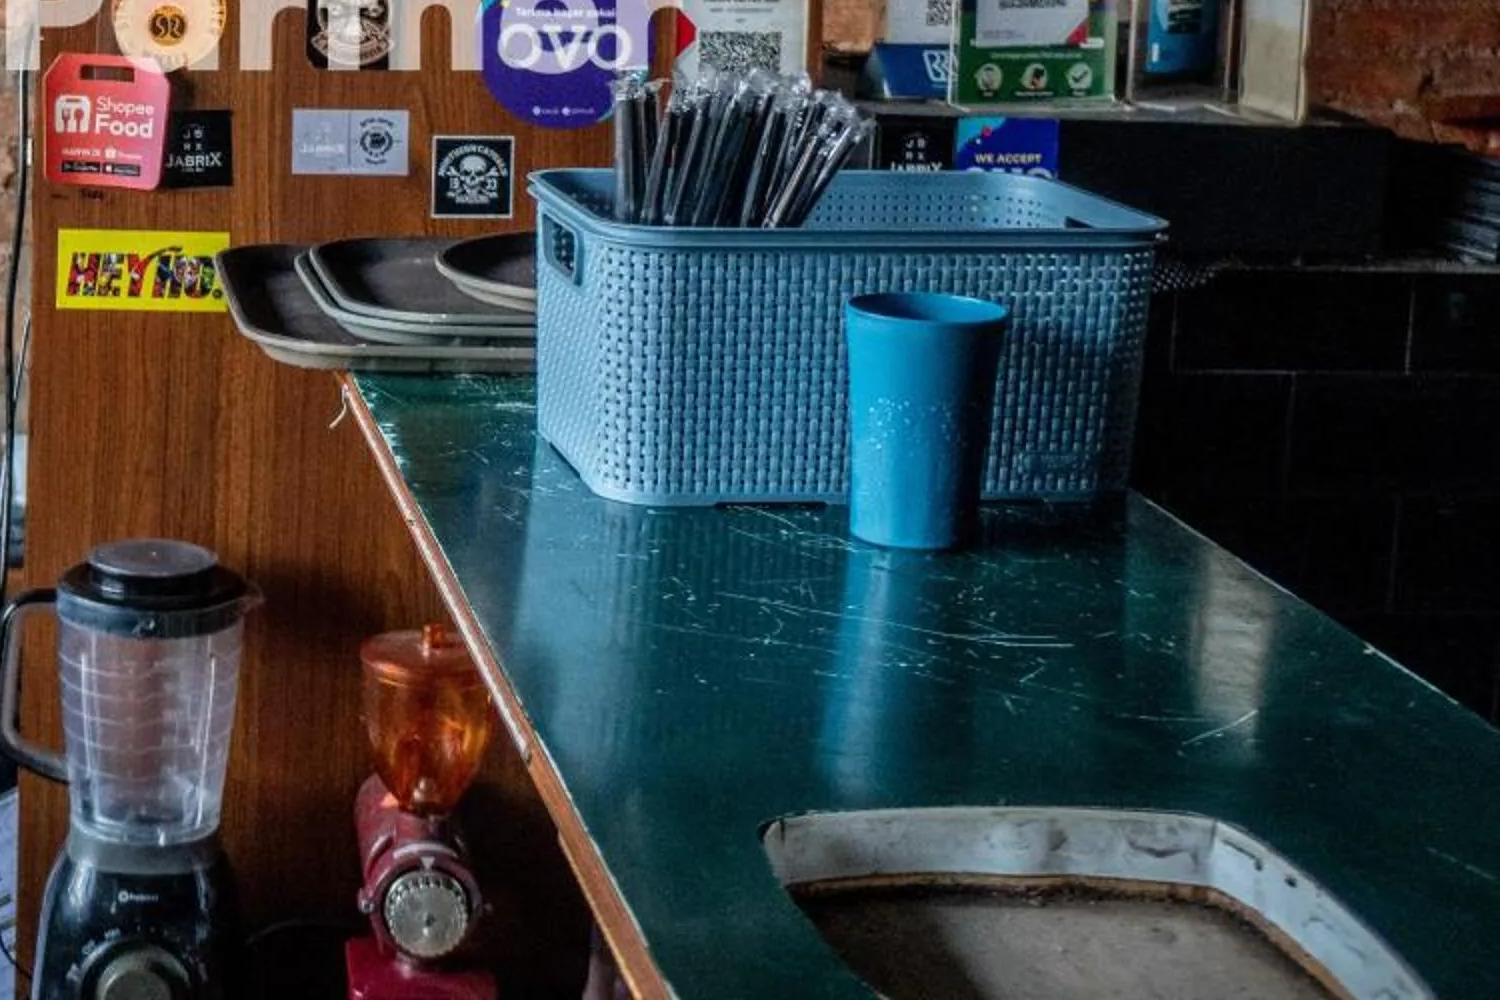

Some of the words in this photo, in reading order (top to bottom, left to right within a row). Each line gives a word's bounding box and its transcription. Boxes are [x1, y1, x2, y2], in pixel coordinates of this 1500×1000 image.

[96, 96, 154, 118] Shopee
[95, 113, 153, 138] Food
[166, 151, 222, 168] JABRIX
[975, 152, 998, 164] WE
[999, 152, 1043, 164] ACCEPT
